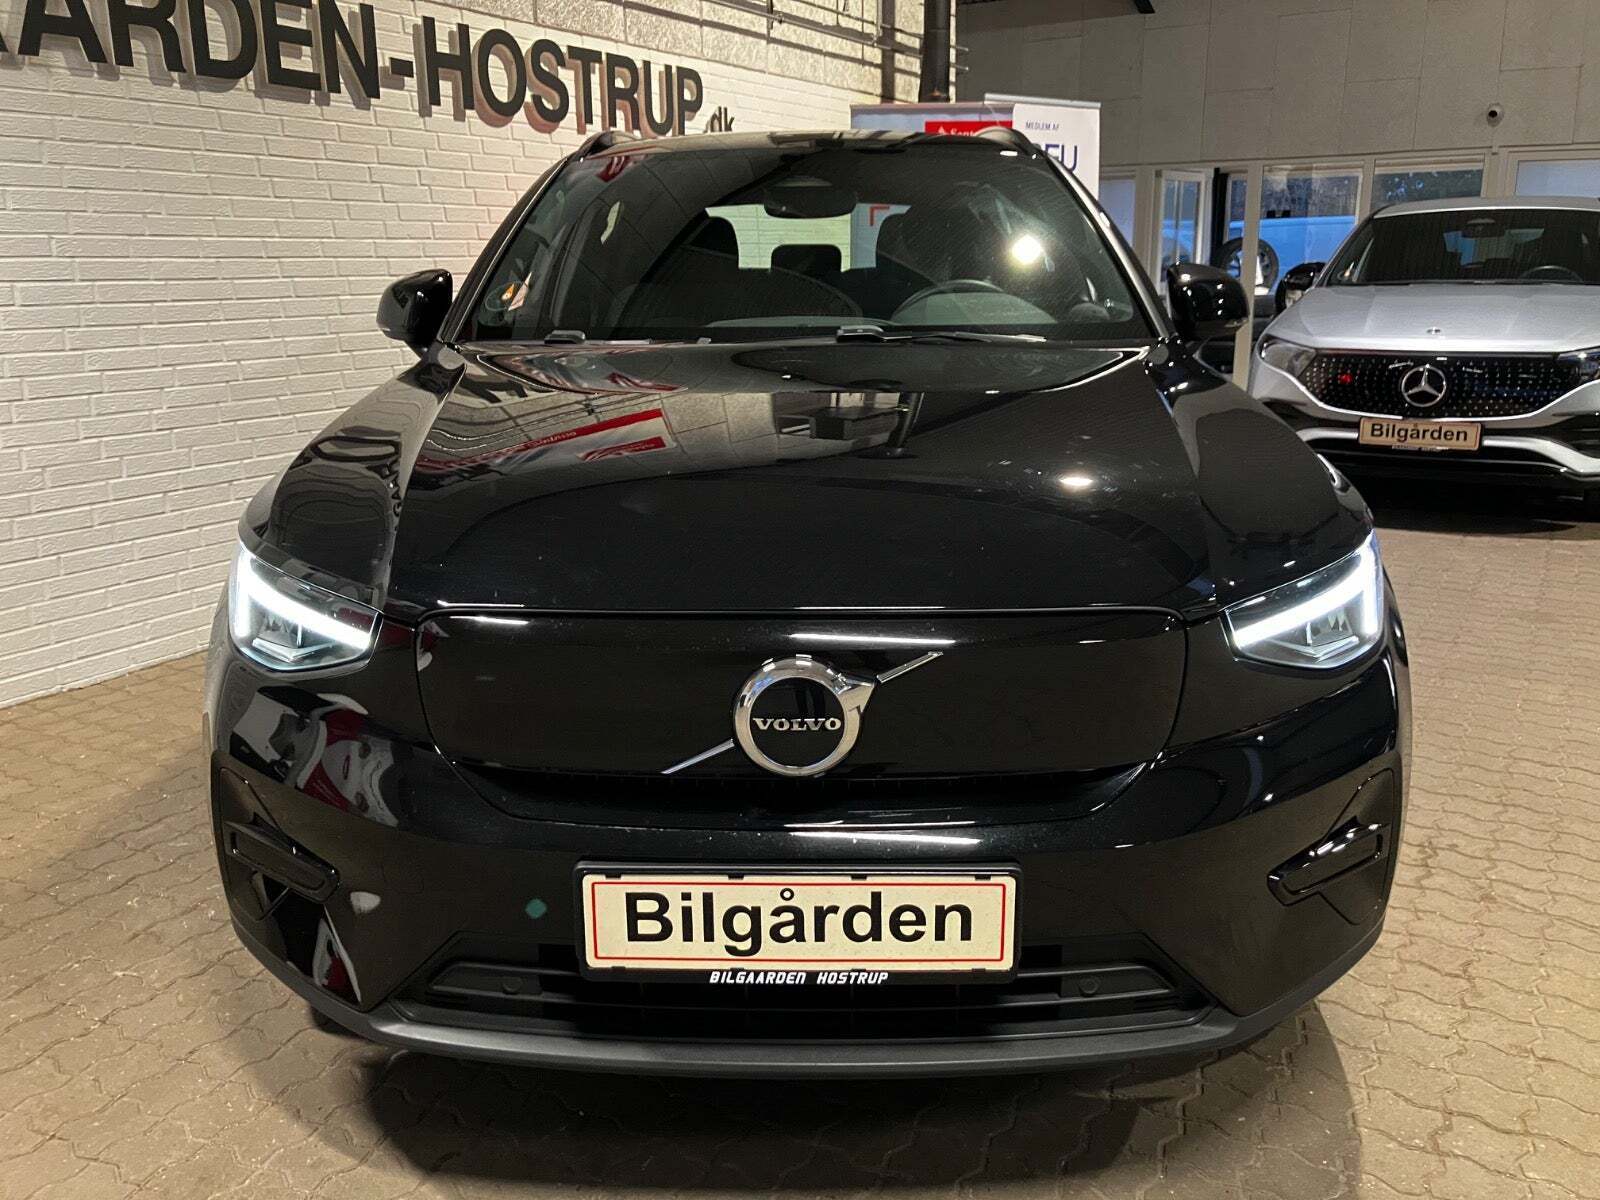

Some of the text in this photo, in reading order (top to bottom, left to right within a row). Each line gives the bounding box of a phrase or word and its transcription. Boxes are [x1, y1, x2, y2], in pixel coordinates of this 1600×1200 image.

[1370, 423, 1468, 442] Bilgården
[752, 717, 842, 731] VOLVO
[624, 887, 973, 957] Bilgården
[709, 971, 889, 984] BILGAARDEN HOSTRUP
